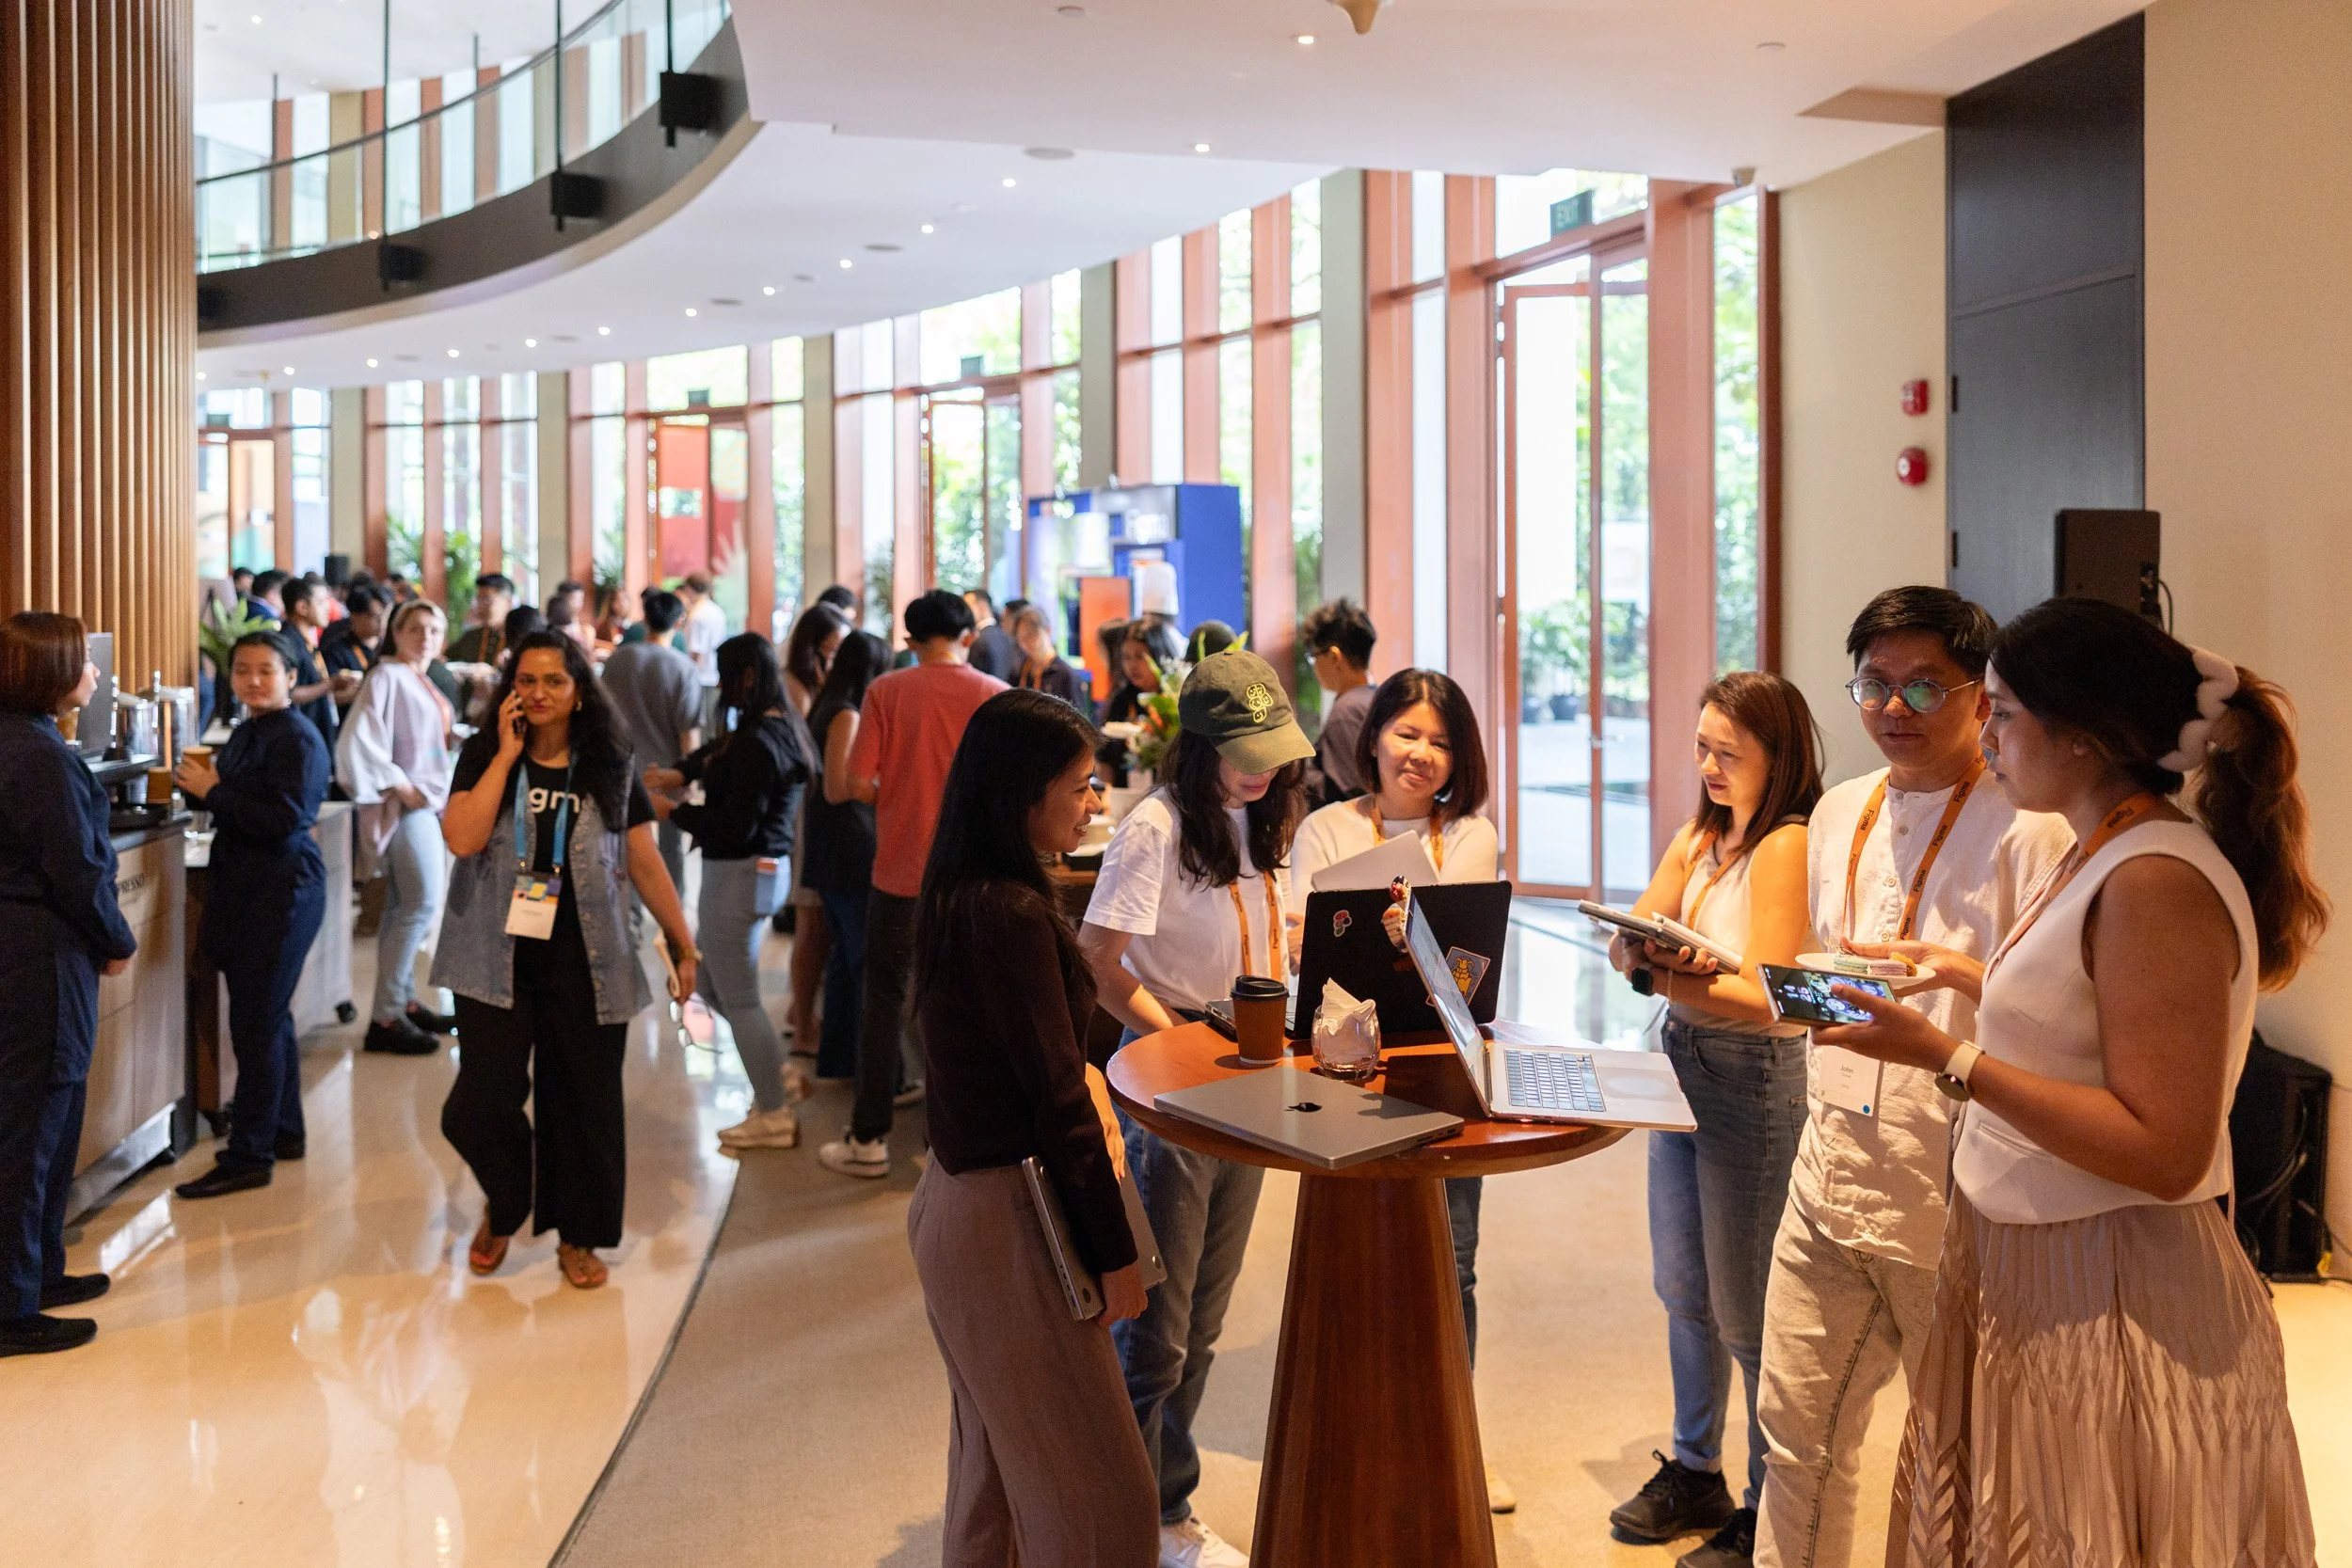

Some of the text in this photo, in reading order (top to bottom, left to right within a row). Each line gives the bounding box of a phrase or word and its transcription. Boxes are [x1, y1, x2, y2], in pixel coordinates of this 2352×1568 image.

[1954, 781, 1970, 803] Figma
[1860, 809, 1875, 832] Figma
[2107, 807, 2135, 828] Figma
[1932, 824, 1947, 847] Figma
[1690, 849, 1701, 864] Figma
[1849, 853, 1857, 876] Figma
[1914, 869, 1927, 893] Figma
[1899, 917, 1912, 941] Figma
[1840, 1065, 1853, 1073] John
